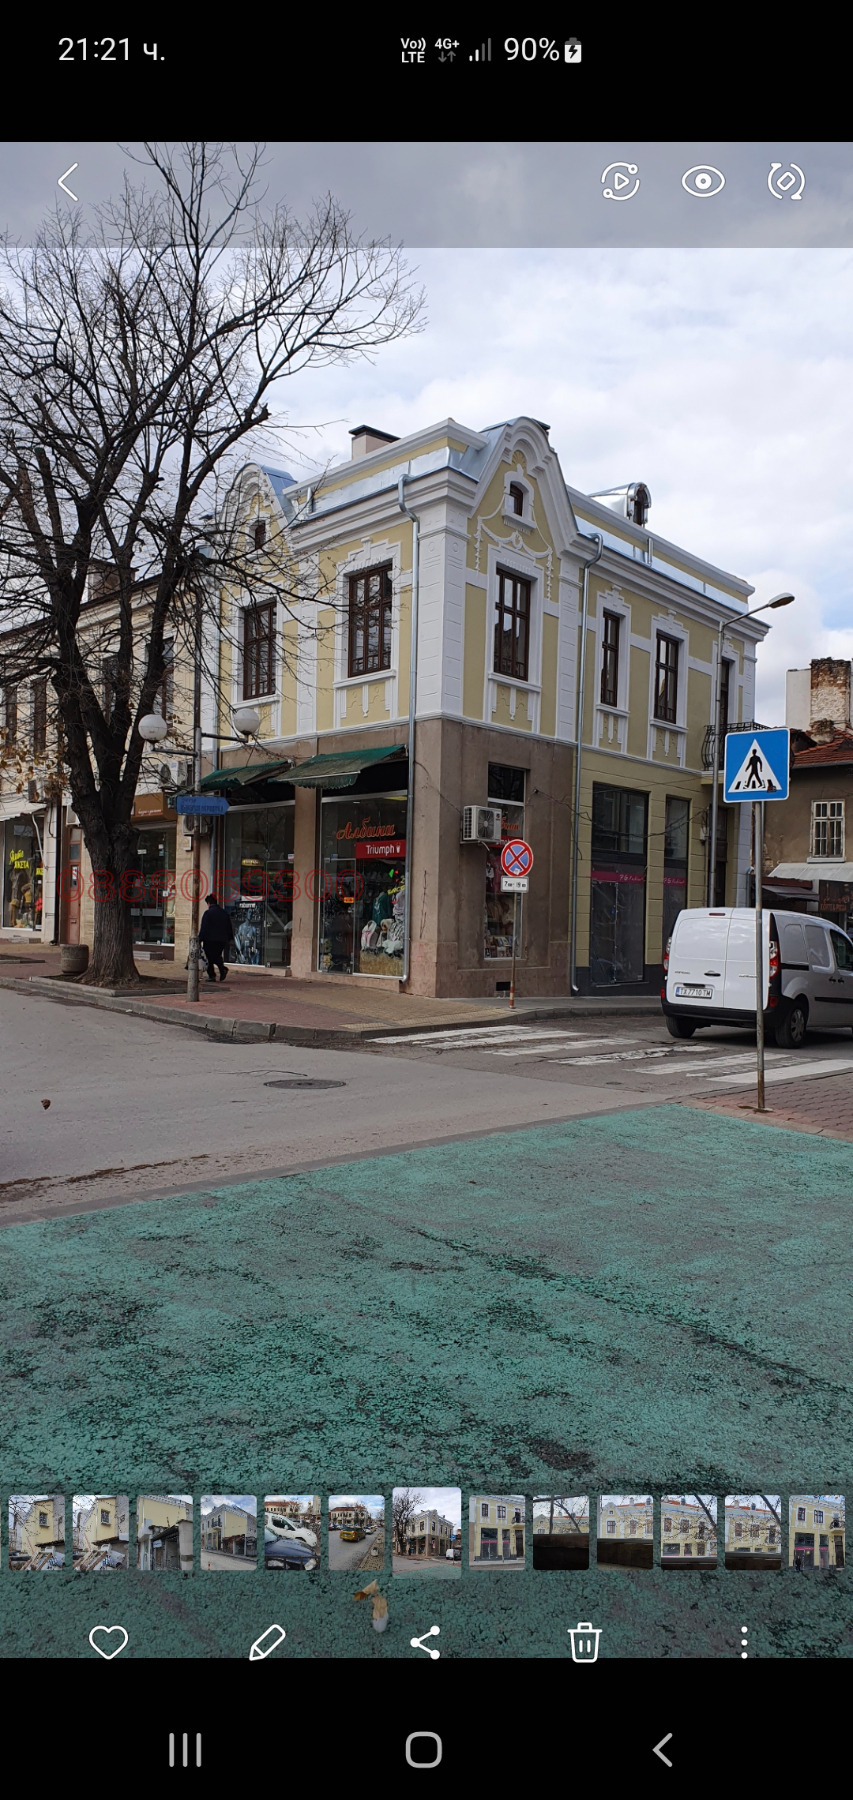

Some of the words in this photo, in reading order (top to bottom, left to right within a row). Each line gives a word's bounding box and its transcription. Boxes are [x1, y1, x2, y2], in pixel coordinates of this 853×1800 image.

[58, 37, 129, 61] 21:21
[143, 42, 165, 61] ч.
[434, 38, 460, 49] 4G+
[504, 37, 560, 61] 90%
[401, 51, 426, 63] LTE
[336, 816, 395, 840] Албини
[366, 844, 395, 856] Triumph
